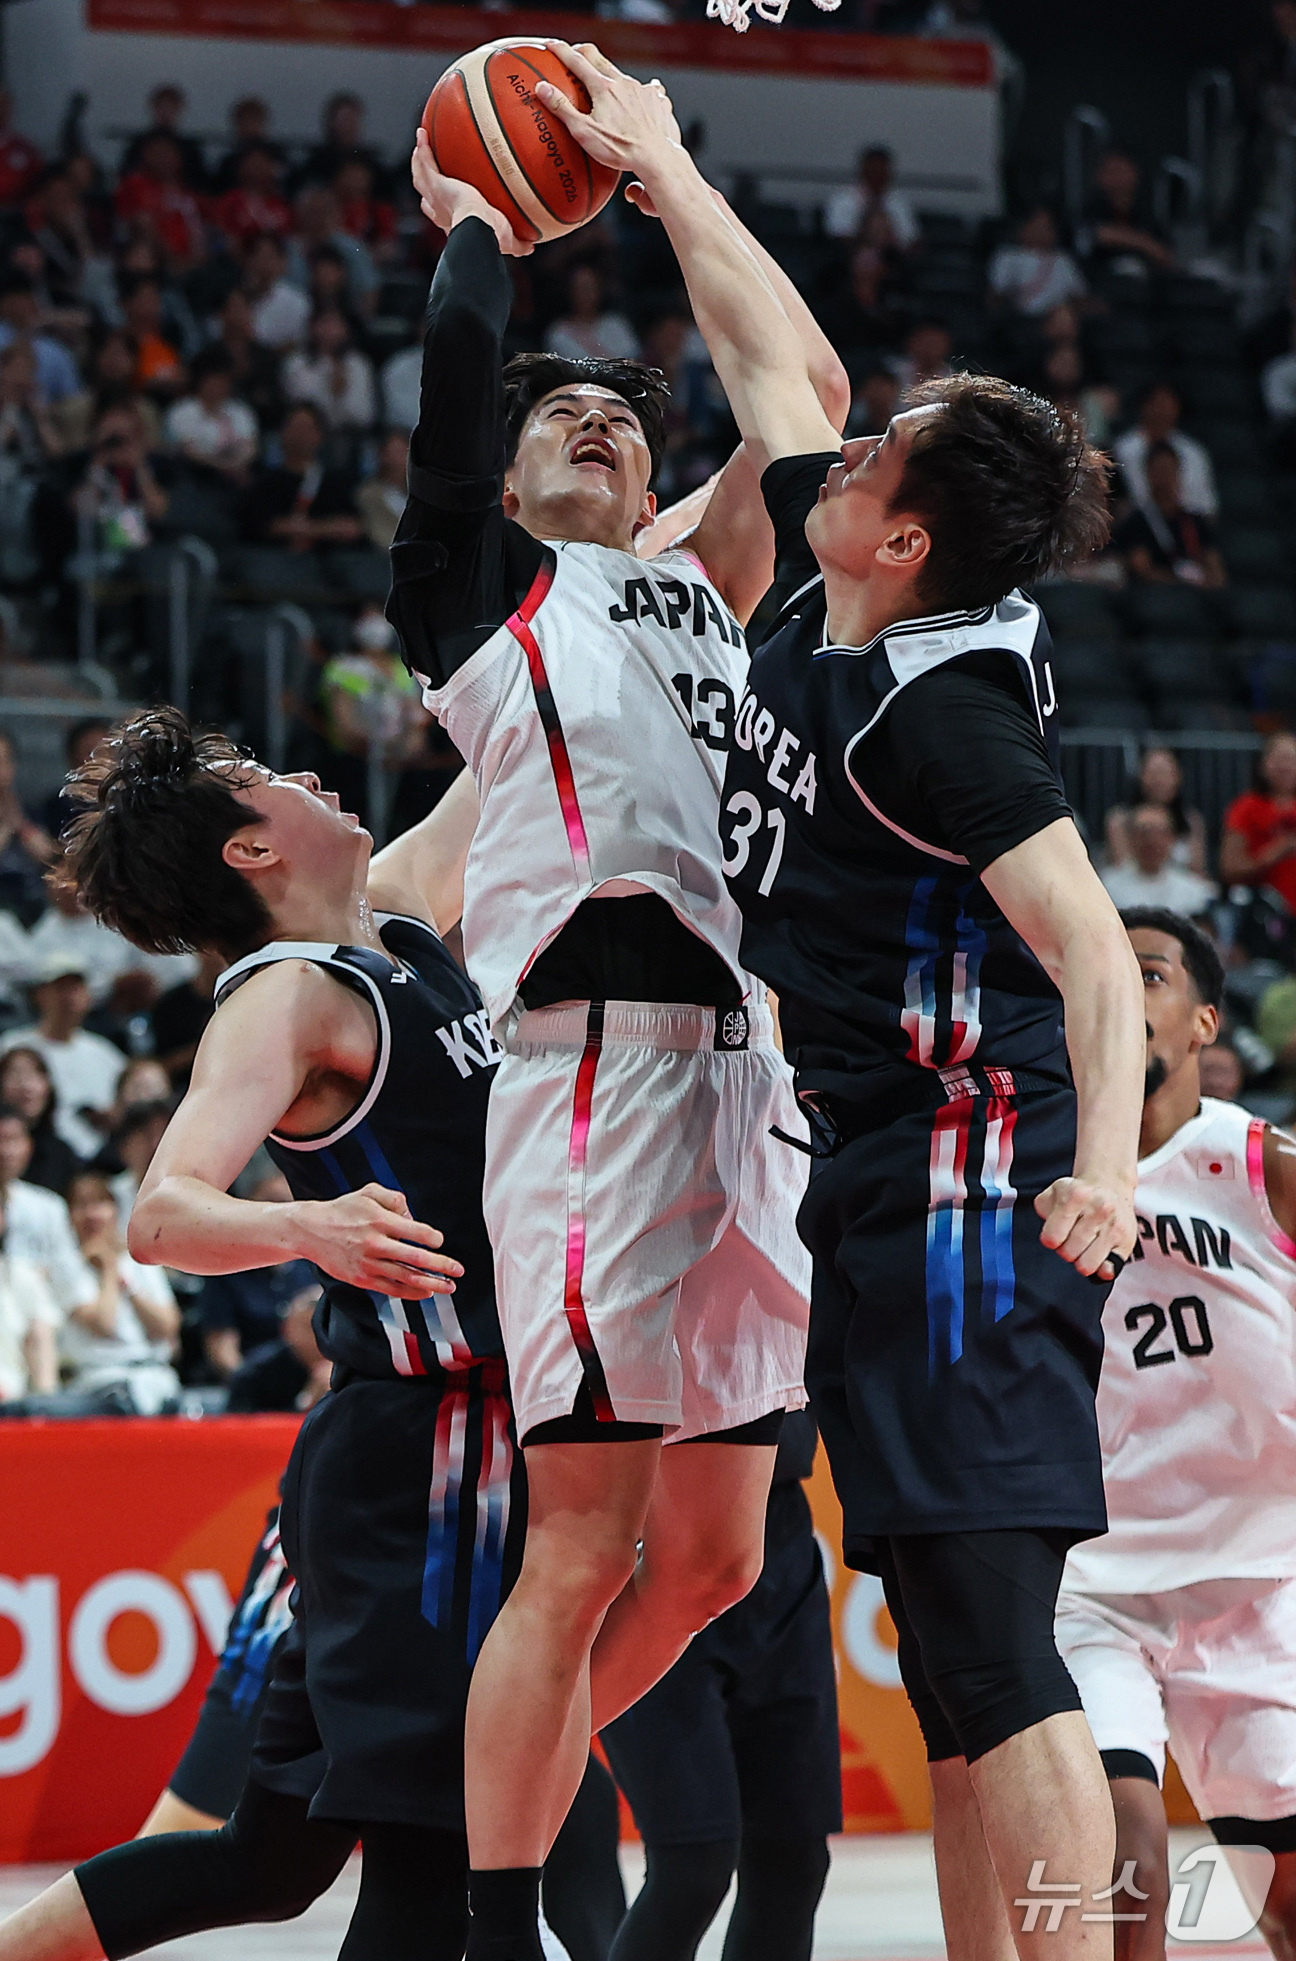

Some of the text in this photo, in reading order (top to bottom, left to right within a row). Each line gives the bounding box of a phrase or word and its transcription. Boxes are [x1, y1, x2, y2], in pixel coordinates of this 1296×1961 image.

[506, 73, 580, 204] Aichi-Nagoya 2026
[671, 672, 737, 752] 13
[734, 687, 818, 816] OREA
[721, 790, 787, 898] 31
[1124, 1214, 1234, 1270] PAN
[1124, 1295, 1214, 1371] 20
